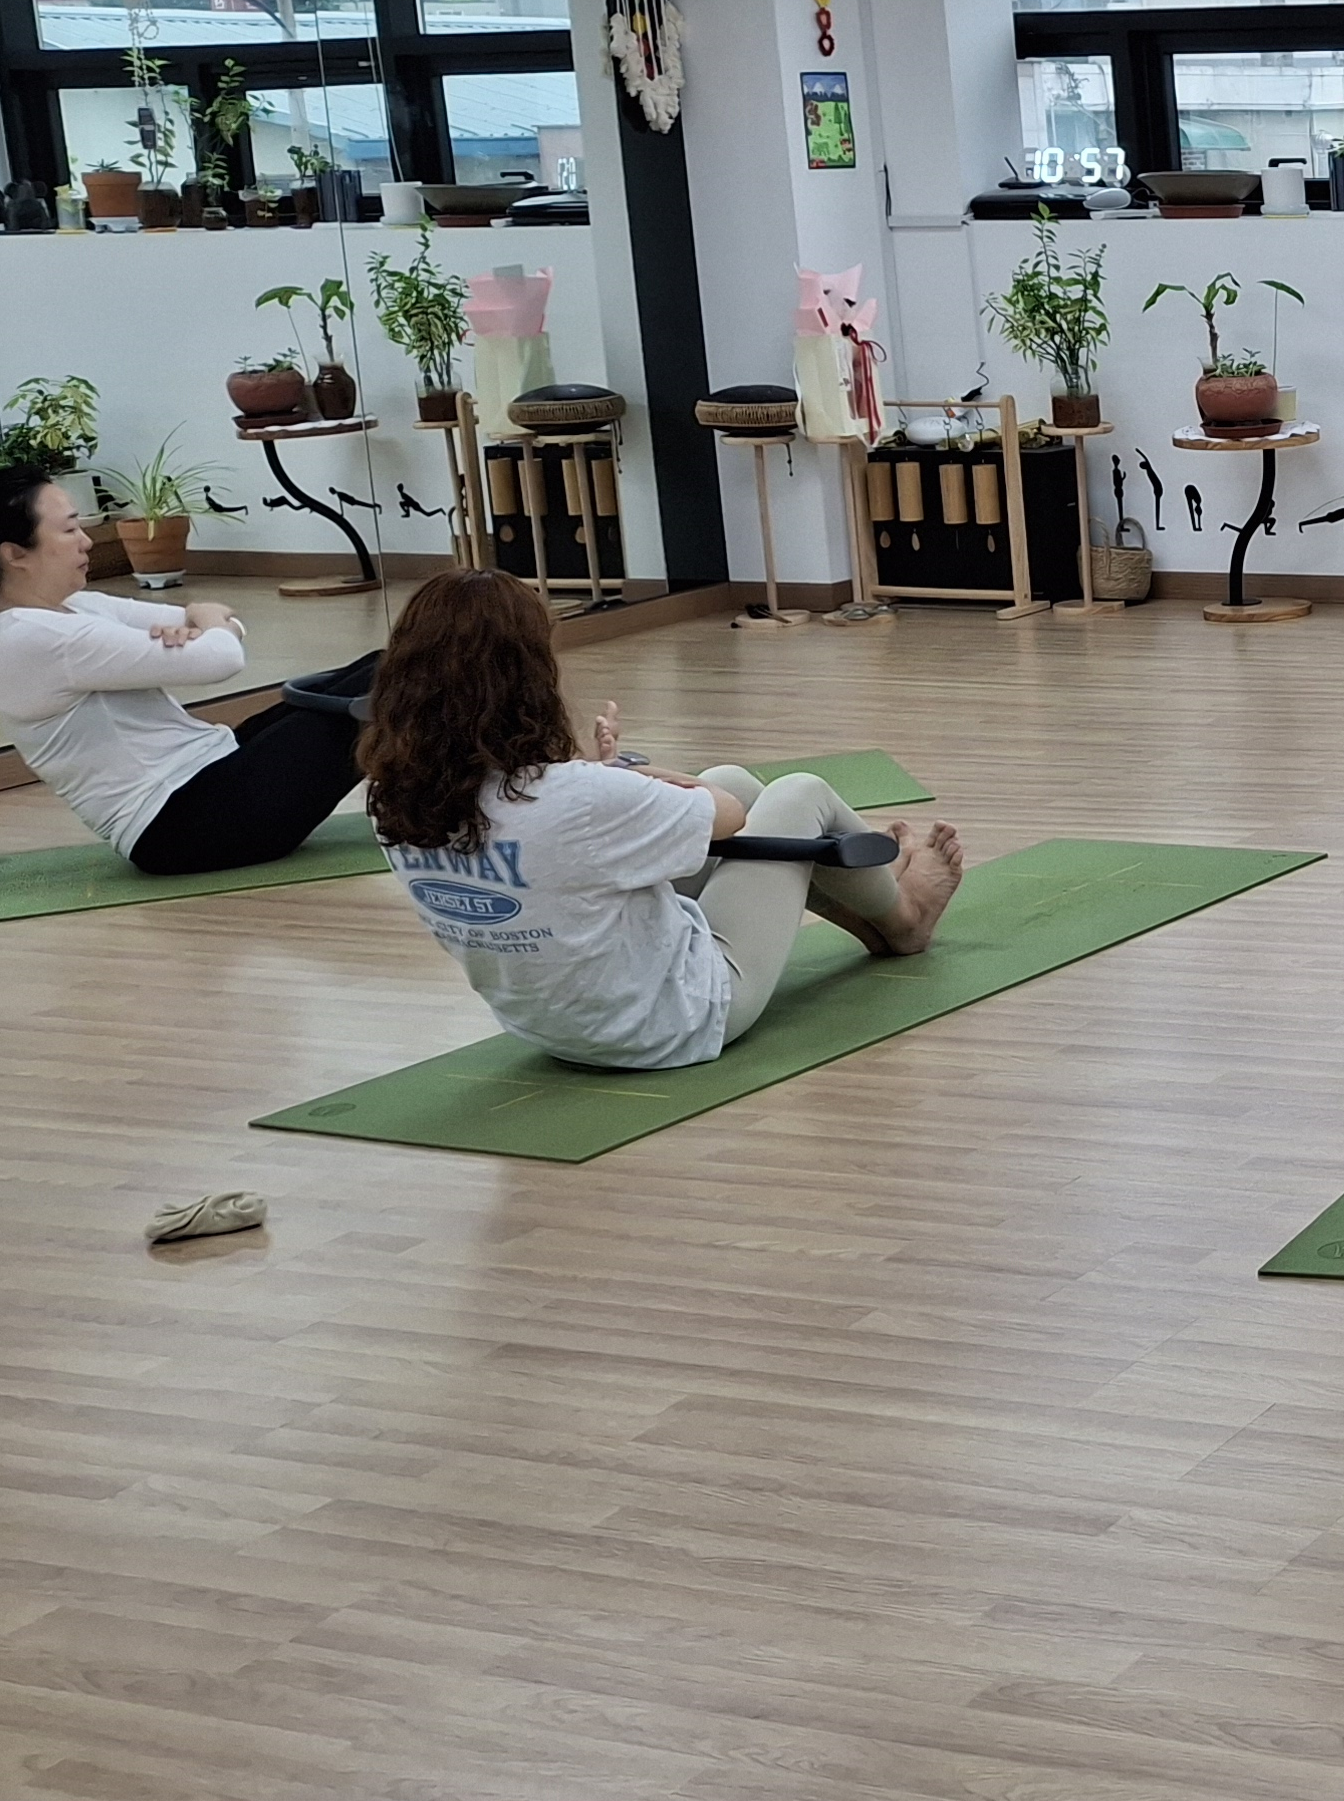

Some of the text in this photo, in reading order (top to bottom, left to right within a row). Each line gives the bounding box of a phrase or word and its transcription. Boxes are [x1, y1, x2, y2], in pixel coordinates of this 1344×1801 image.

[1033, 147, 1126, 184] 10:57
[387, 839, 530, 888] ENWAY
[423, 888, 495, 913] JERSEY ST
[488, 927, 554, 942] BOSTON
